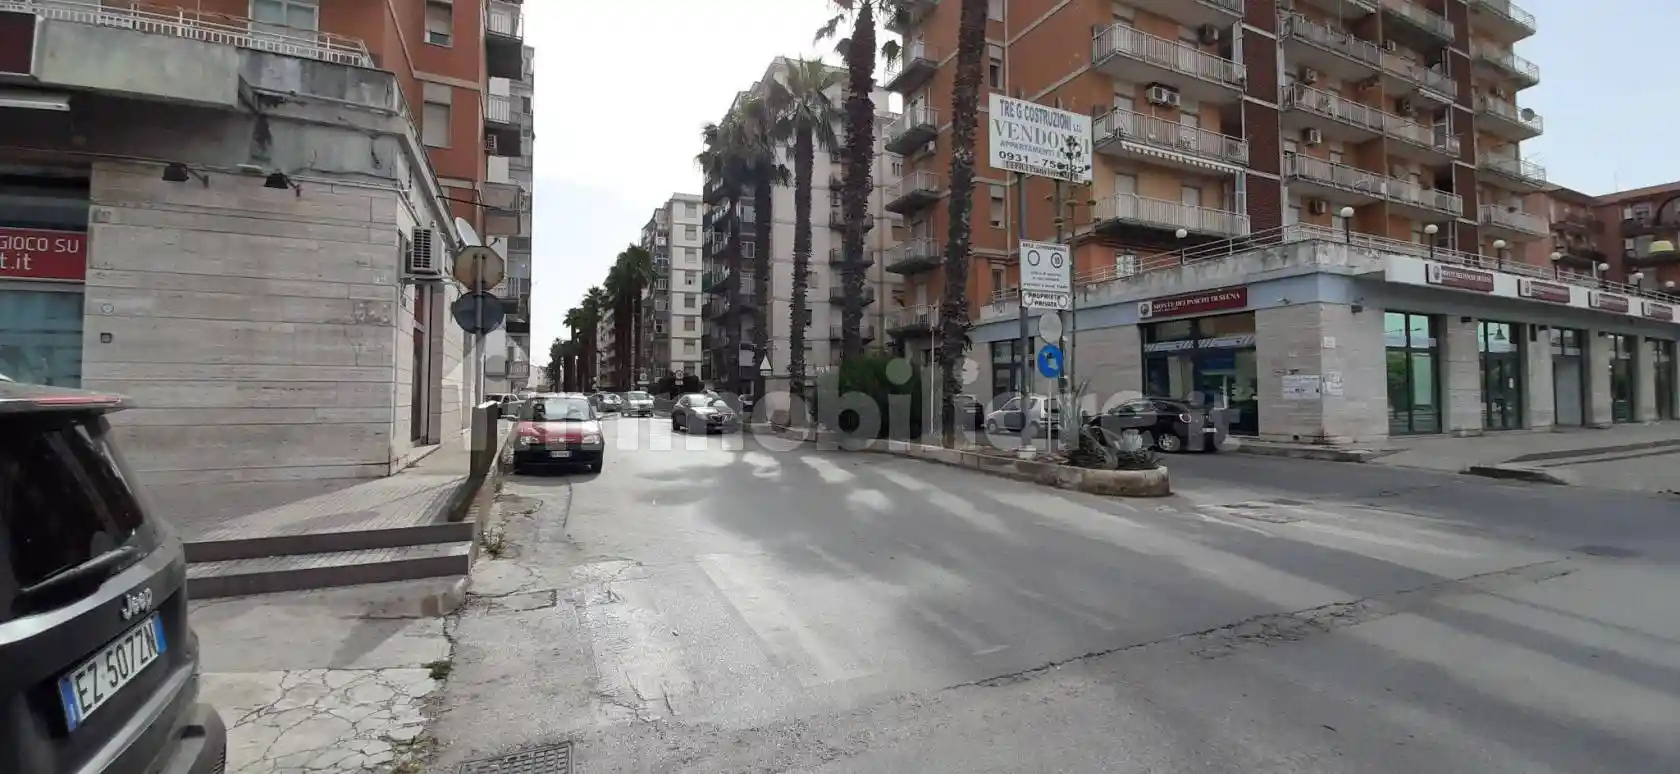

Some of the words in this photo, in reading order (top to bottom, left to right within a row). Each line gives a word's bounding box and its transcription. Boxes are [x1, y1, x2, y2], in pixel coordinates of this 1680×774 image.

[1000, 99, 1014, 117] TRE
[1016, 103, 1022, 118] G
[1025, 105, 1071, 131] COSTRUZIONI
[999, 150, 1028, 162] 0931
[0, 235, 48, 251] GIOCO
[55, 238, 79, 253] SU
[121, 587, 152, 620] Jeep
[75, 661, 103, 715] EZ
[106, 619, 158, 689] 507ZN
